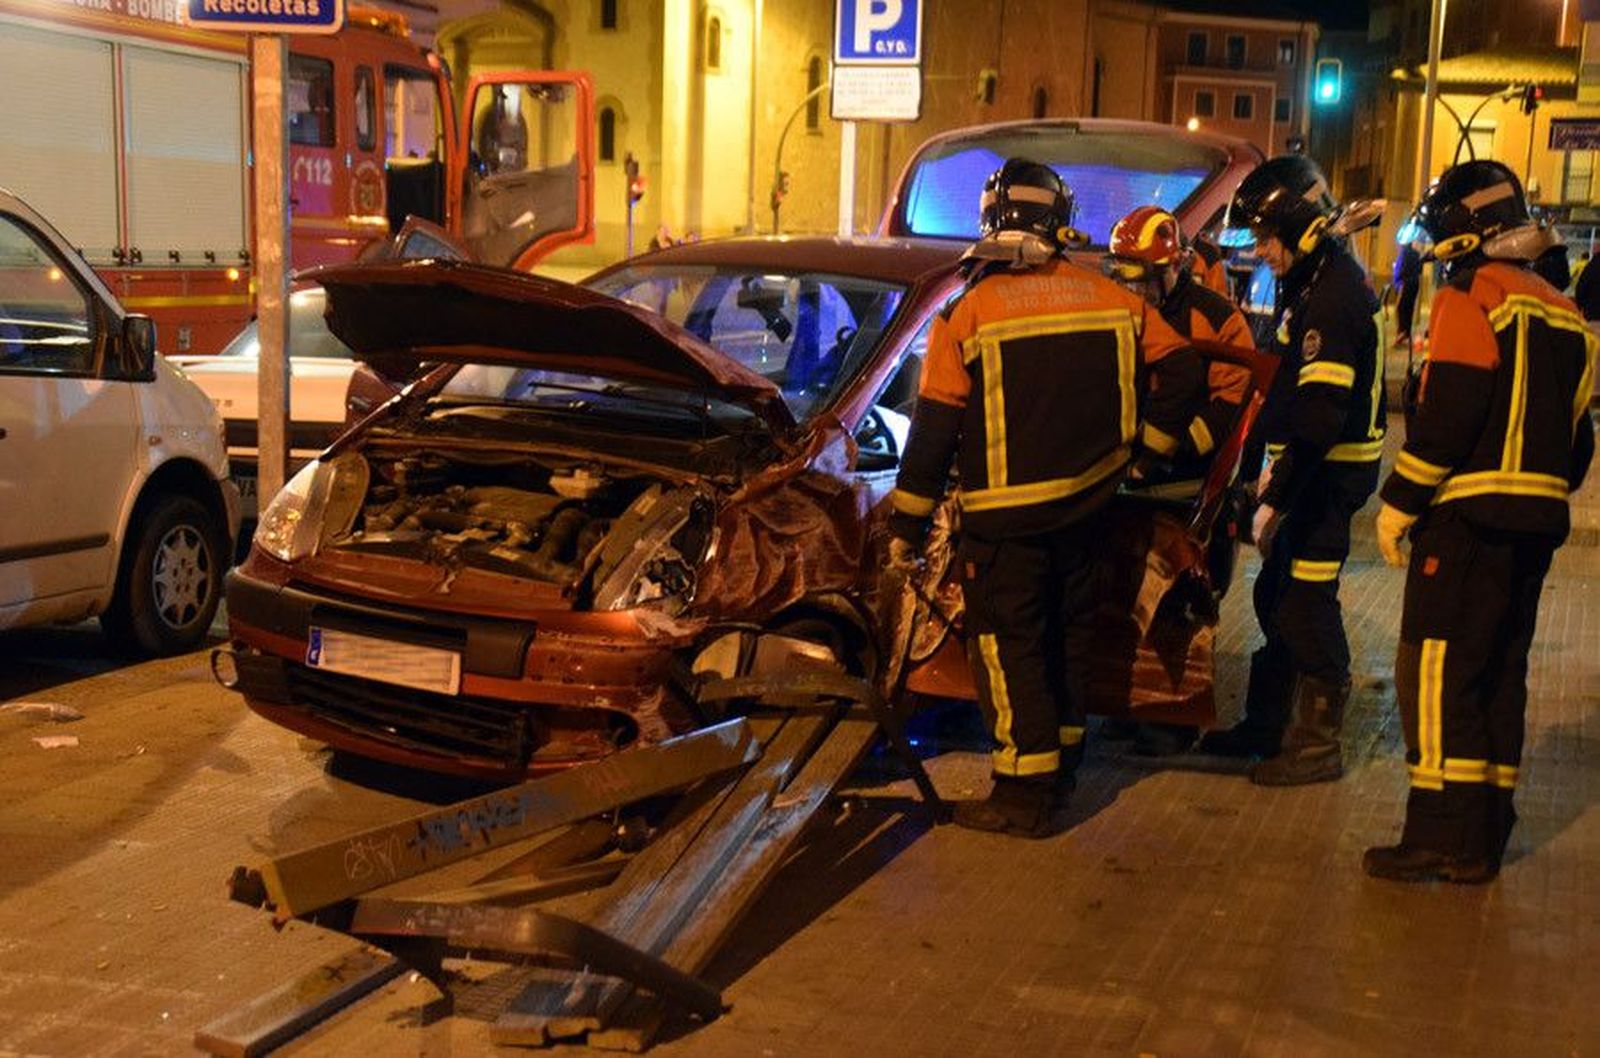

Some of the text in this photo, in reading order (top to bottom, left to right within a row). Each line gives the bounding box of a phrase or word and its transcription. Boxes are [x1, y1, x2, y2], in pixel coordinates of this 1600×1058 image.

[203, 0, 321, 16] Recoletas
[854, 0, 903, 53] P
[305, 158, 333, 186] 112
